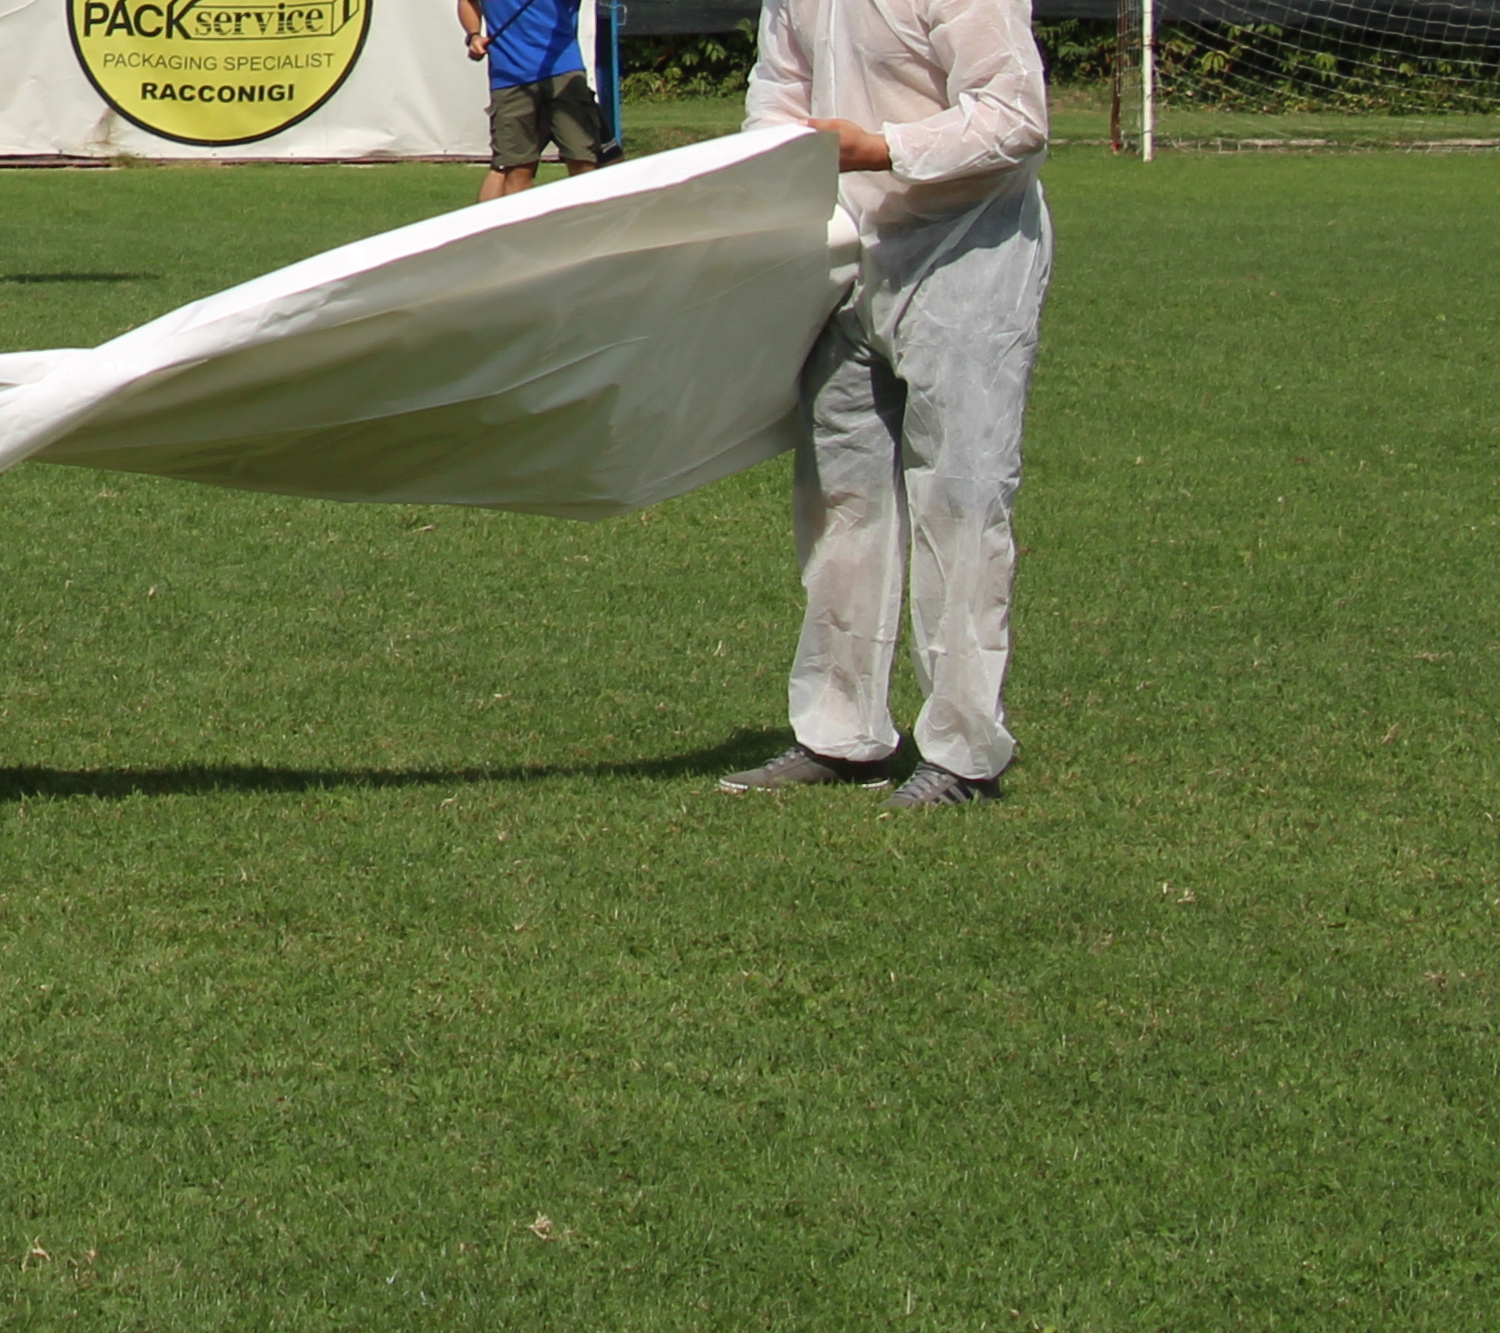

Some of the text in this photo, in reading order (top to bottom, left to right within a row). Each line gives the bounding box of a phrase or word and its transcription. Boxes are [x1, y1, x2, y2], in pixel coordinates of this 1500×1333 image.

[102, 51, 336, 72] PACKAGING SPECIALIST
[140, 83, 296, 103] RACCONIGI
